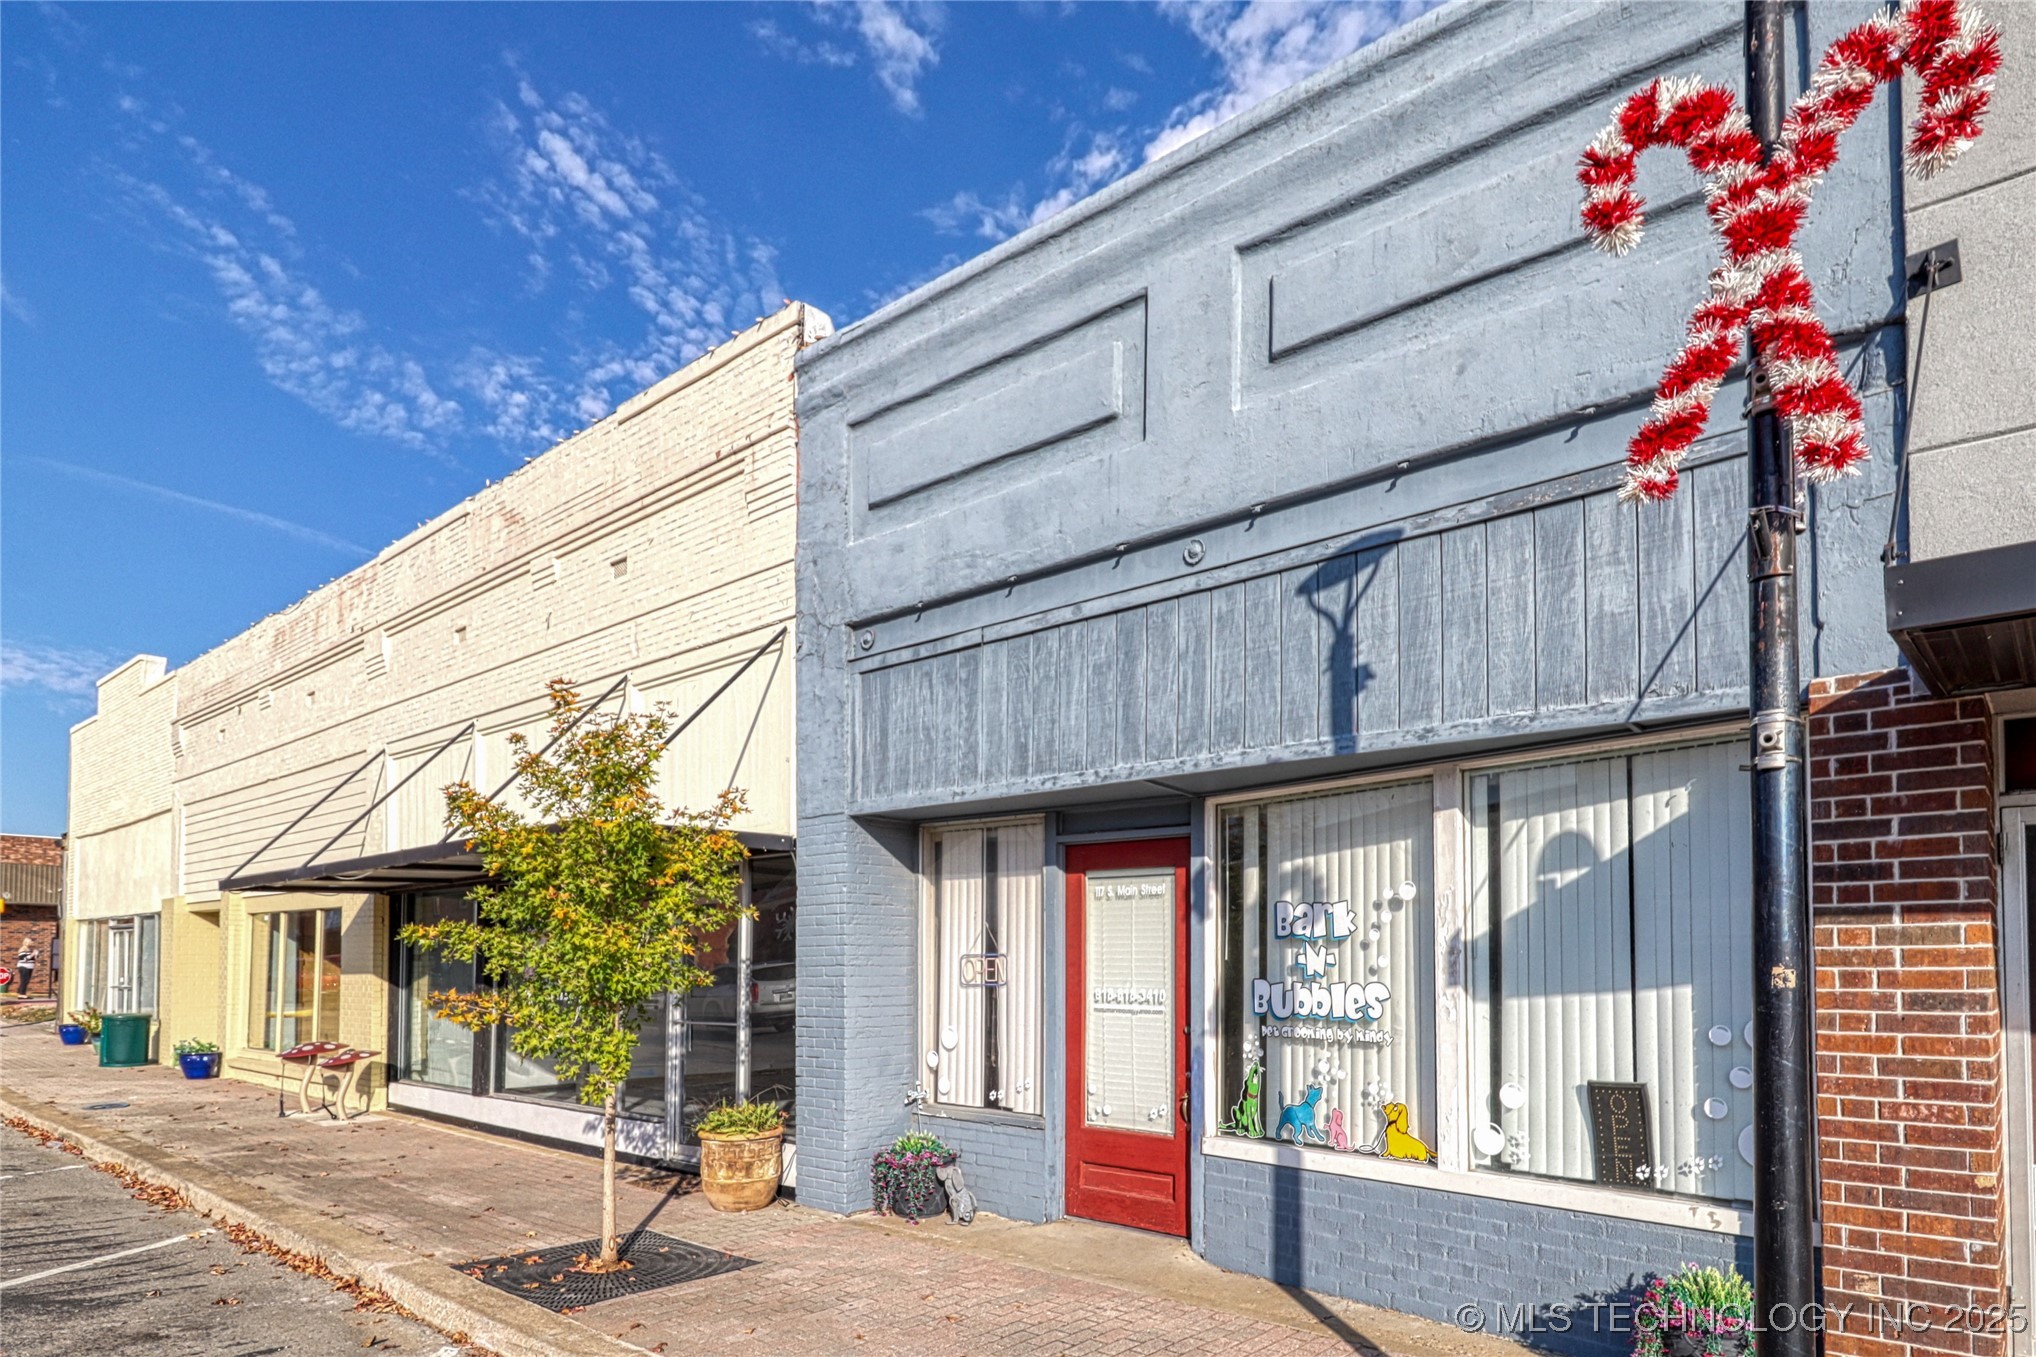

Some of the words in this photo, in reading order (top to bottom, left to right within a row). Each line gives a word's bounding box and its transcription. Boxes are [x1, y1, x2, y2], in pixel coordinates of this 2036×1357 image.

[1095, 886, 1105, 897] 117
[1107, 885, 1115, 897] S.
[1117, 884, 1138, 896] Main
[1141, 883, 1166, 895] Street
[1275, 900, 1358, 940] Bark
[963, 958, 1006, 983] OPEN
[1252, 978, 1392, 1023] Bubbles
[1337, 1028, 1353, 1044] by
[1355, 1029, 1395, 1047] Mindy
[1609, 1093, 1634, 1181] OPEN
